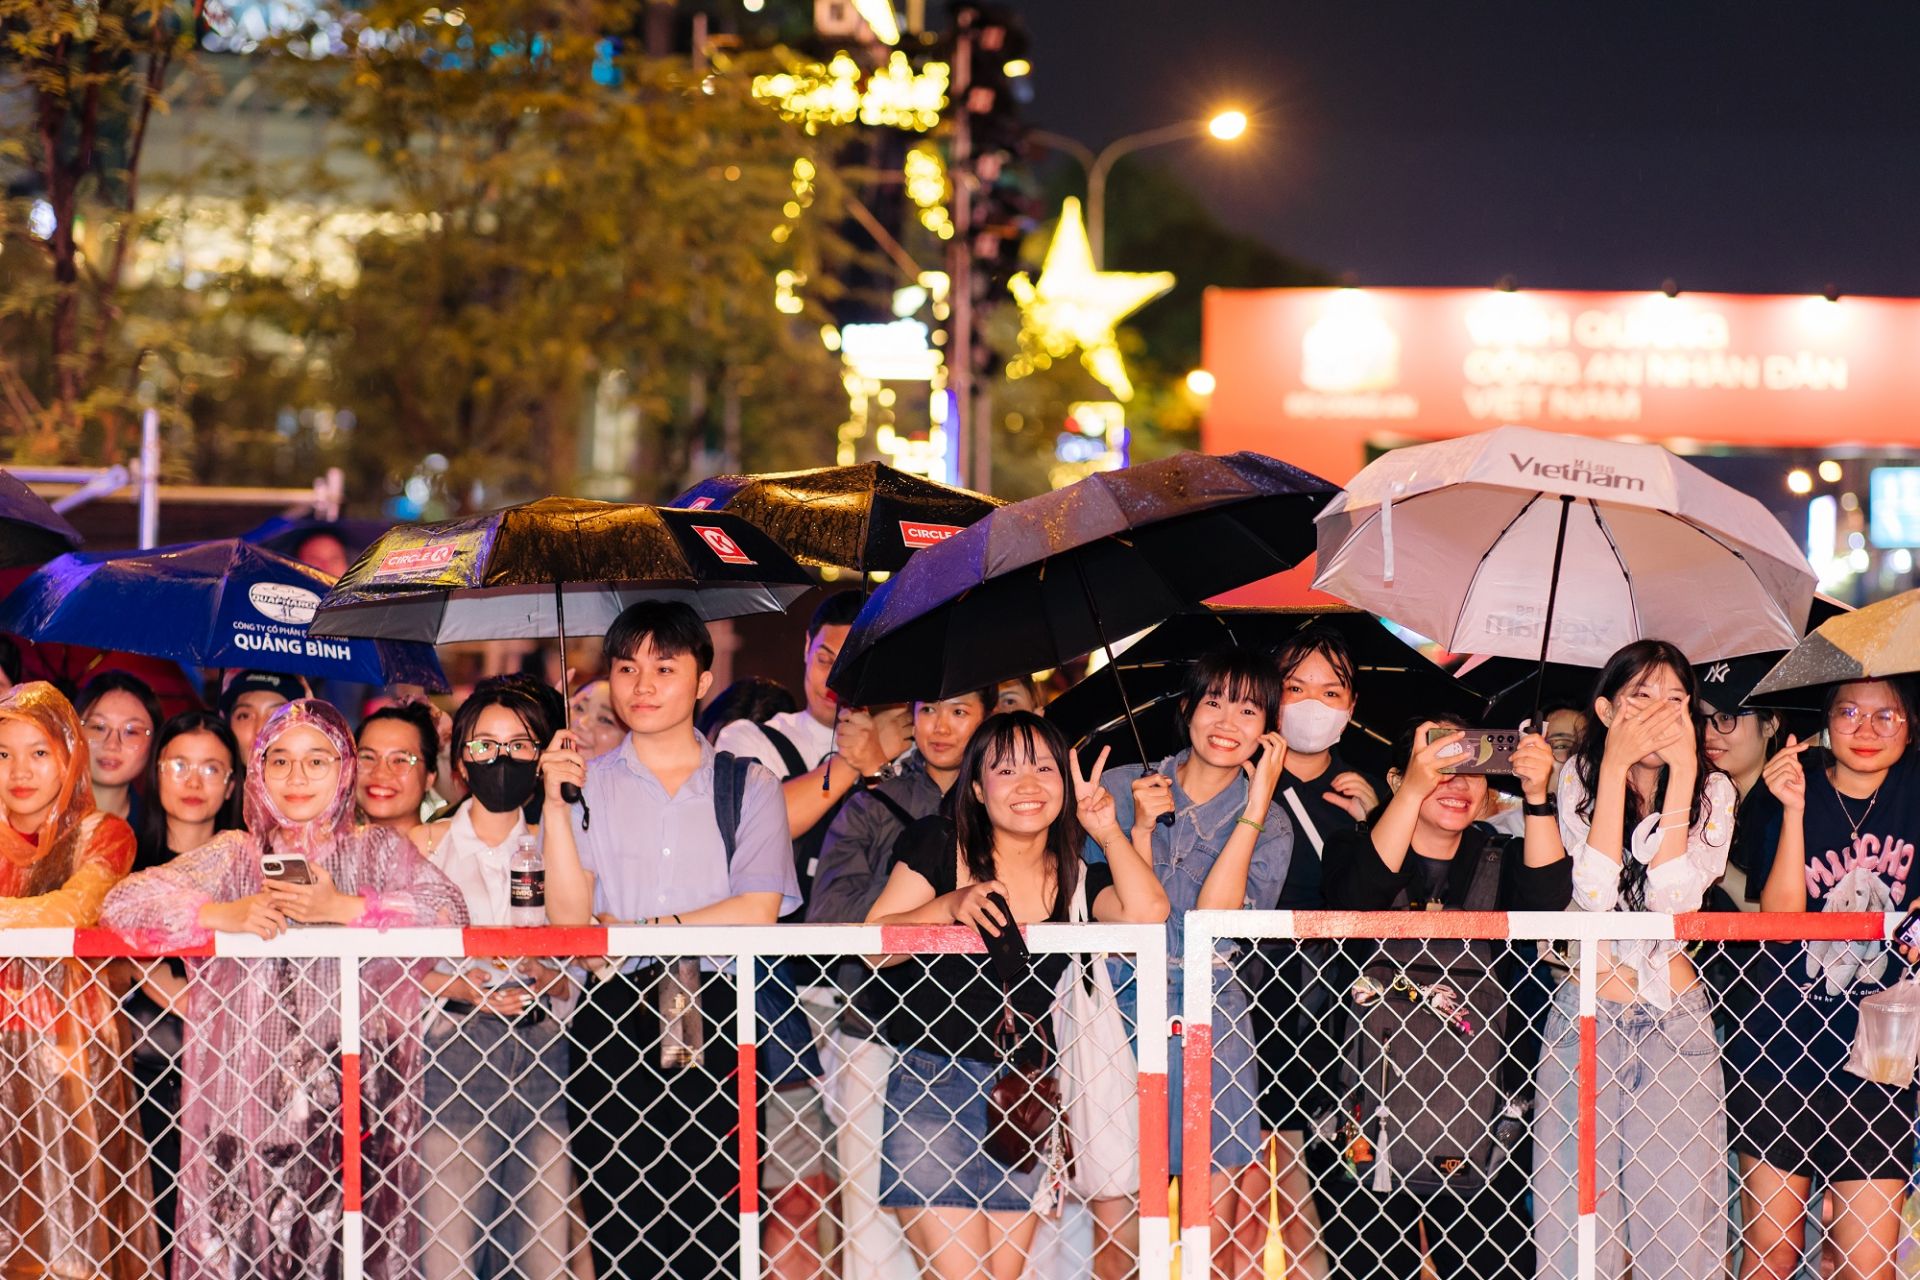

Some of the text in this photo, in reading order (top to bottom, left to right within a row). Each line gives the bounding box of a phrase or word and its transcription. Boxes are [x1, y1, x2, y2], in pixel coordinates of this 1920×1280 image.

[1510, 453, 1645, 492] Vietnam
[388, 552, 431, 566] CIRCLE
[256, 623, 265, 632] TY
[234, 632, 302, 655] QUẢNG
[305, 640, 351, 661] BÌNH
[1704, 662, 1730, 683] NY
